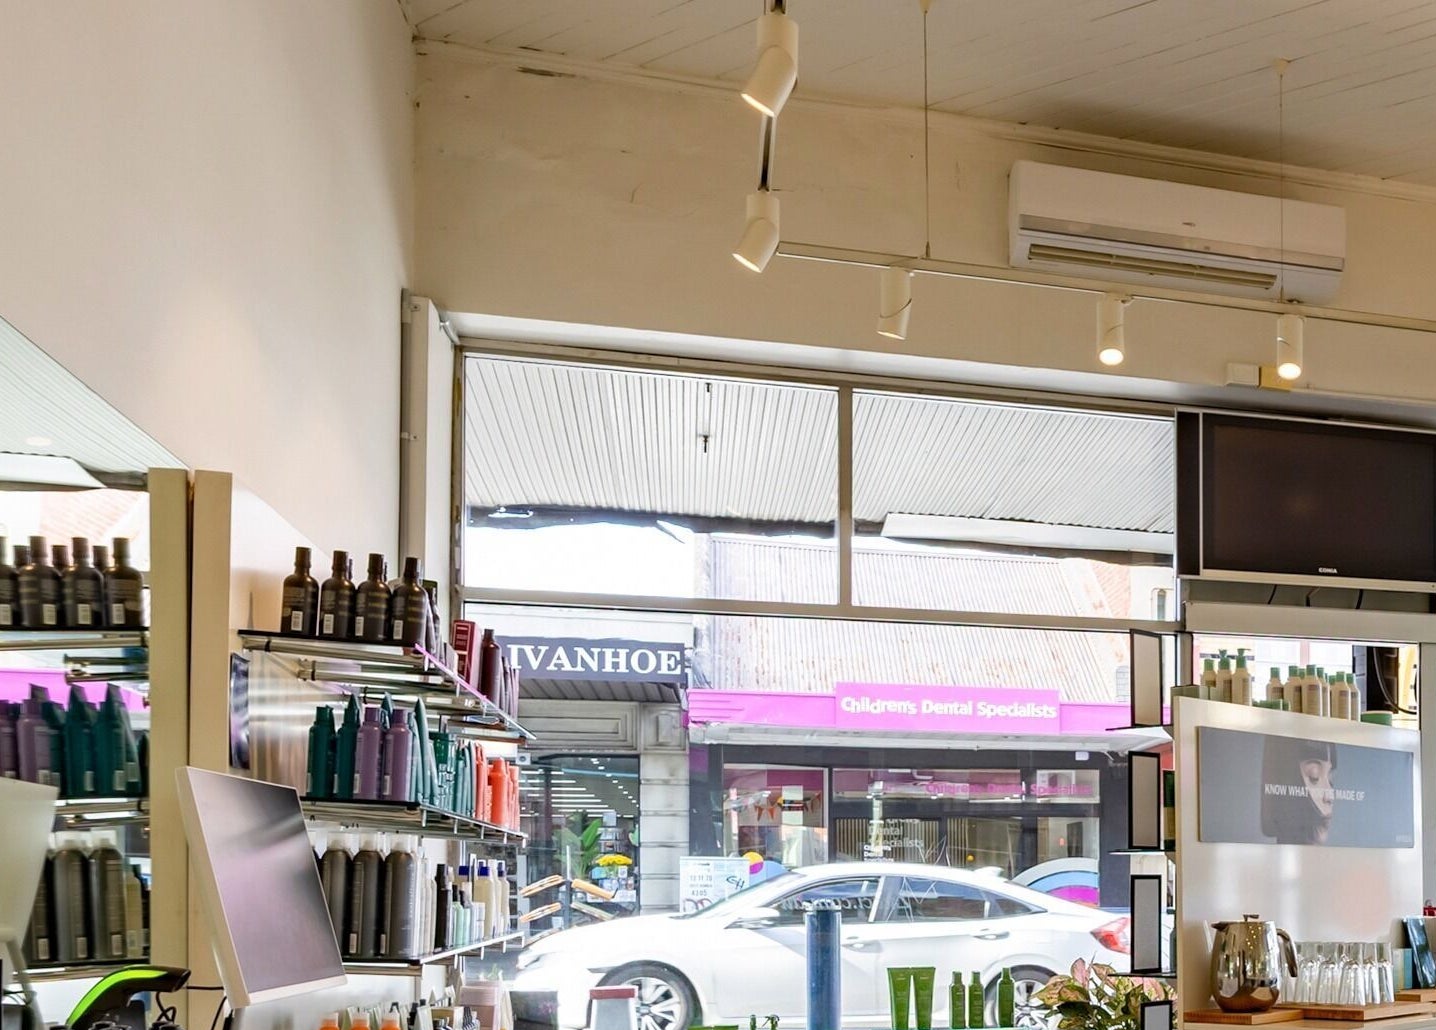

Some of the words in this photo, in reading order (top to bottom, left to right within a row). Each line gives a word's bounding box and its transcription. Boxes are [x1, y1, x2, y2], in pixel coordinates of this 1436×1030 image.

[507, 644, 683, 675] IVANHOE
[840, 696, 918, 715] Children's
[921, 700, 973, 716] Dental
[977, 701, 1058, 719] Specialists
[1264, 783, 1288, 796] KNOW
[1288, 785, 1309, 798] WHAT
[1336, 789, 1356, 801] MADE
[1356, 791, 1365, 801] OF
